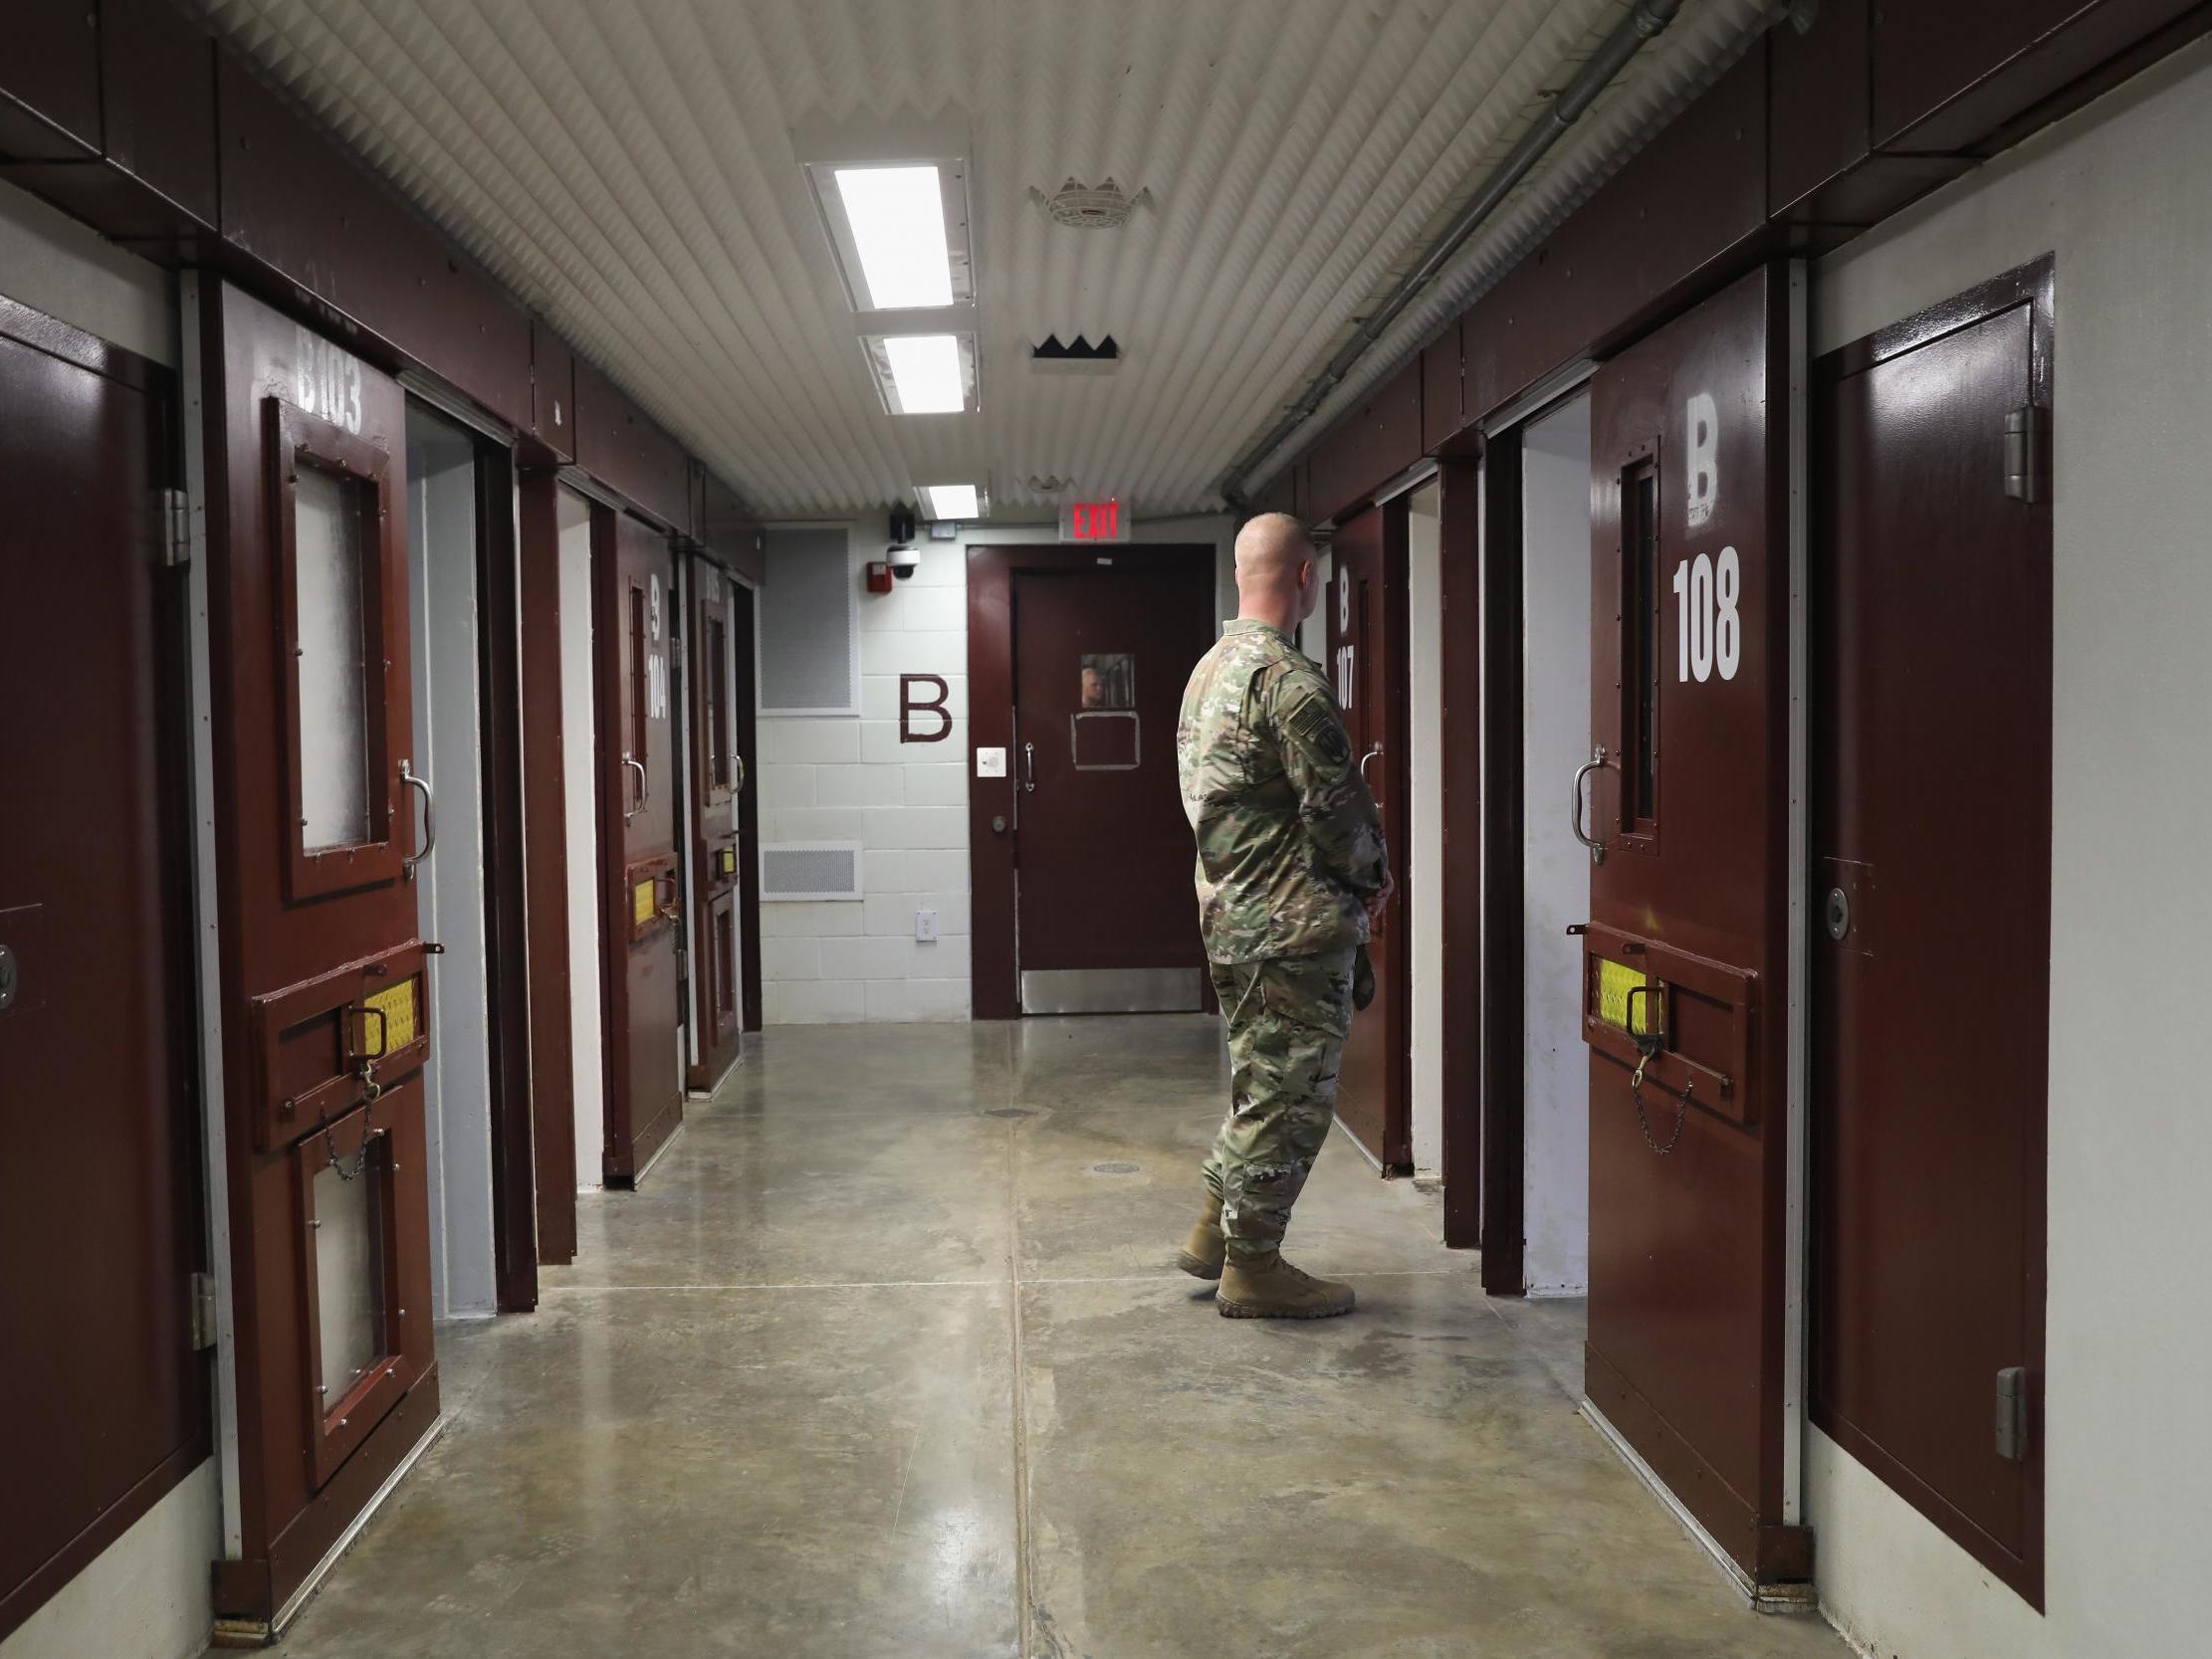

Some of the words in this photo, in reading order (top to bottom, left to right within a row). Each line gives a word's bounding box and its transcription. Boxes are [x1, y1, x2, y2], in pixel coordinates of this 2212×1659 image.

[1687, 393, 1718, 526] B
[1073, 503, 1119, 538] EXIT
[1340, 566, 1349, 634] B
[1673, 545, 1740, 683] 108
[649, 654, 666, 719] 104
[900, 673, 953, 743] B
[1337, 645, 1354, 710] 107
